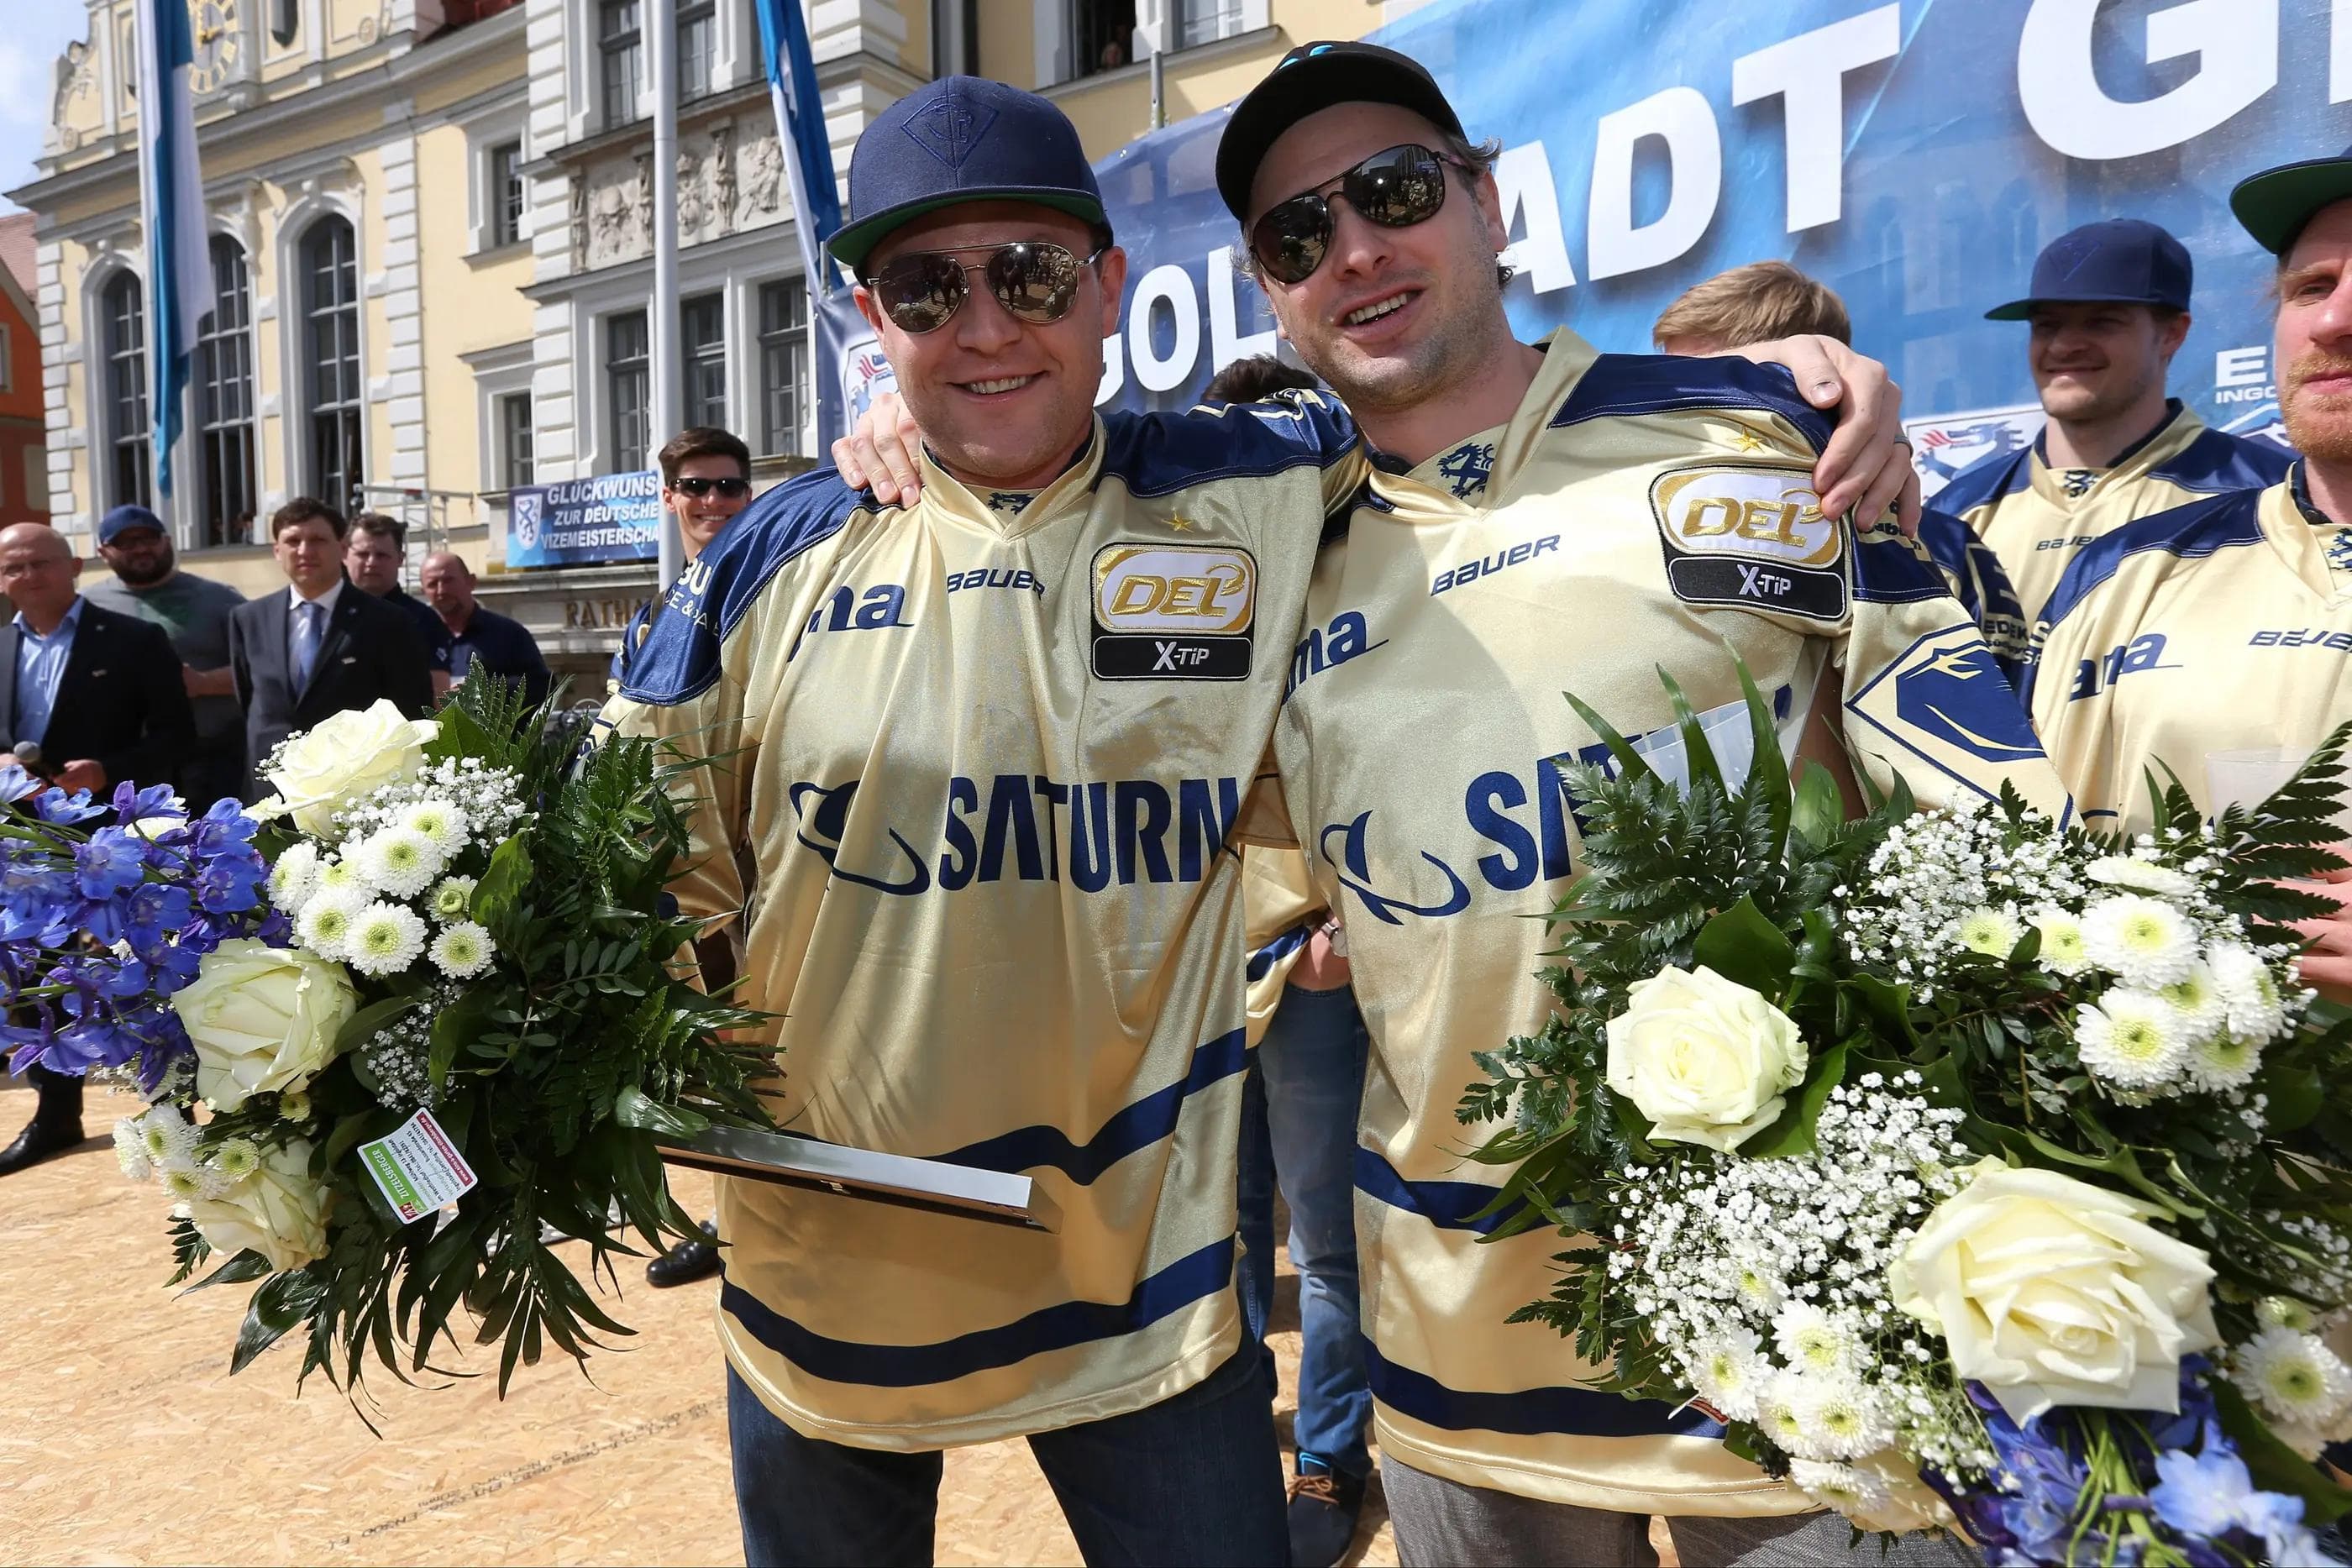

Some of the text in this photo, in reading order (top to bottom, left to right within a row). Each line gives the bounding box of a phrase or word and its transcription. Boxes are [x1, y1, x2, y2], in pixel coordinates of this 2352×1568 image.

[547, 475, 658, 506] GLÜCKWUNS
[554, 509, 581, 527] ZUR
[584, 502, 659, 525] DEUTSCHE
[541, 526, 659, 550] VIZEMEISTERSCHA
[938, 774, 1240, 893] SATURN
[370, 1148, 410, 1200] ZITZELSBERGER
